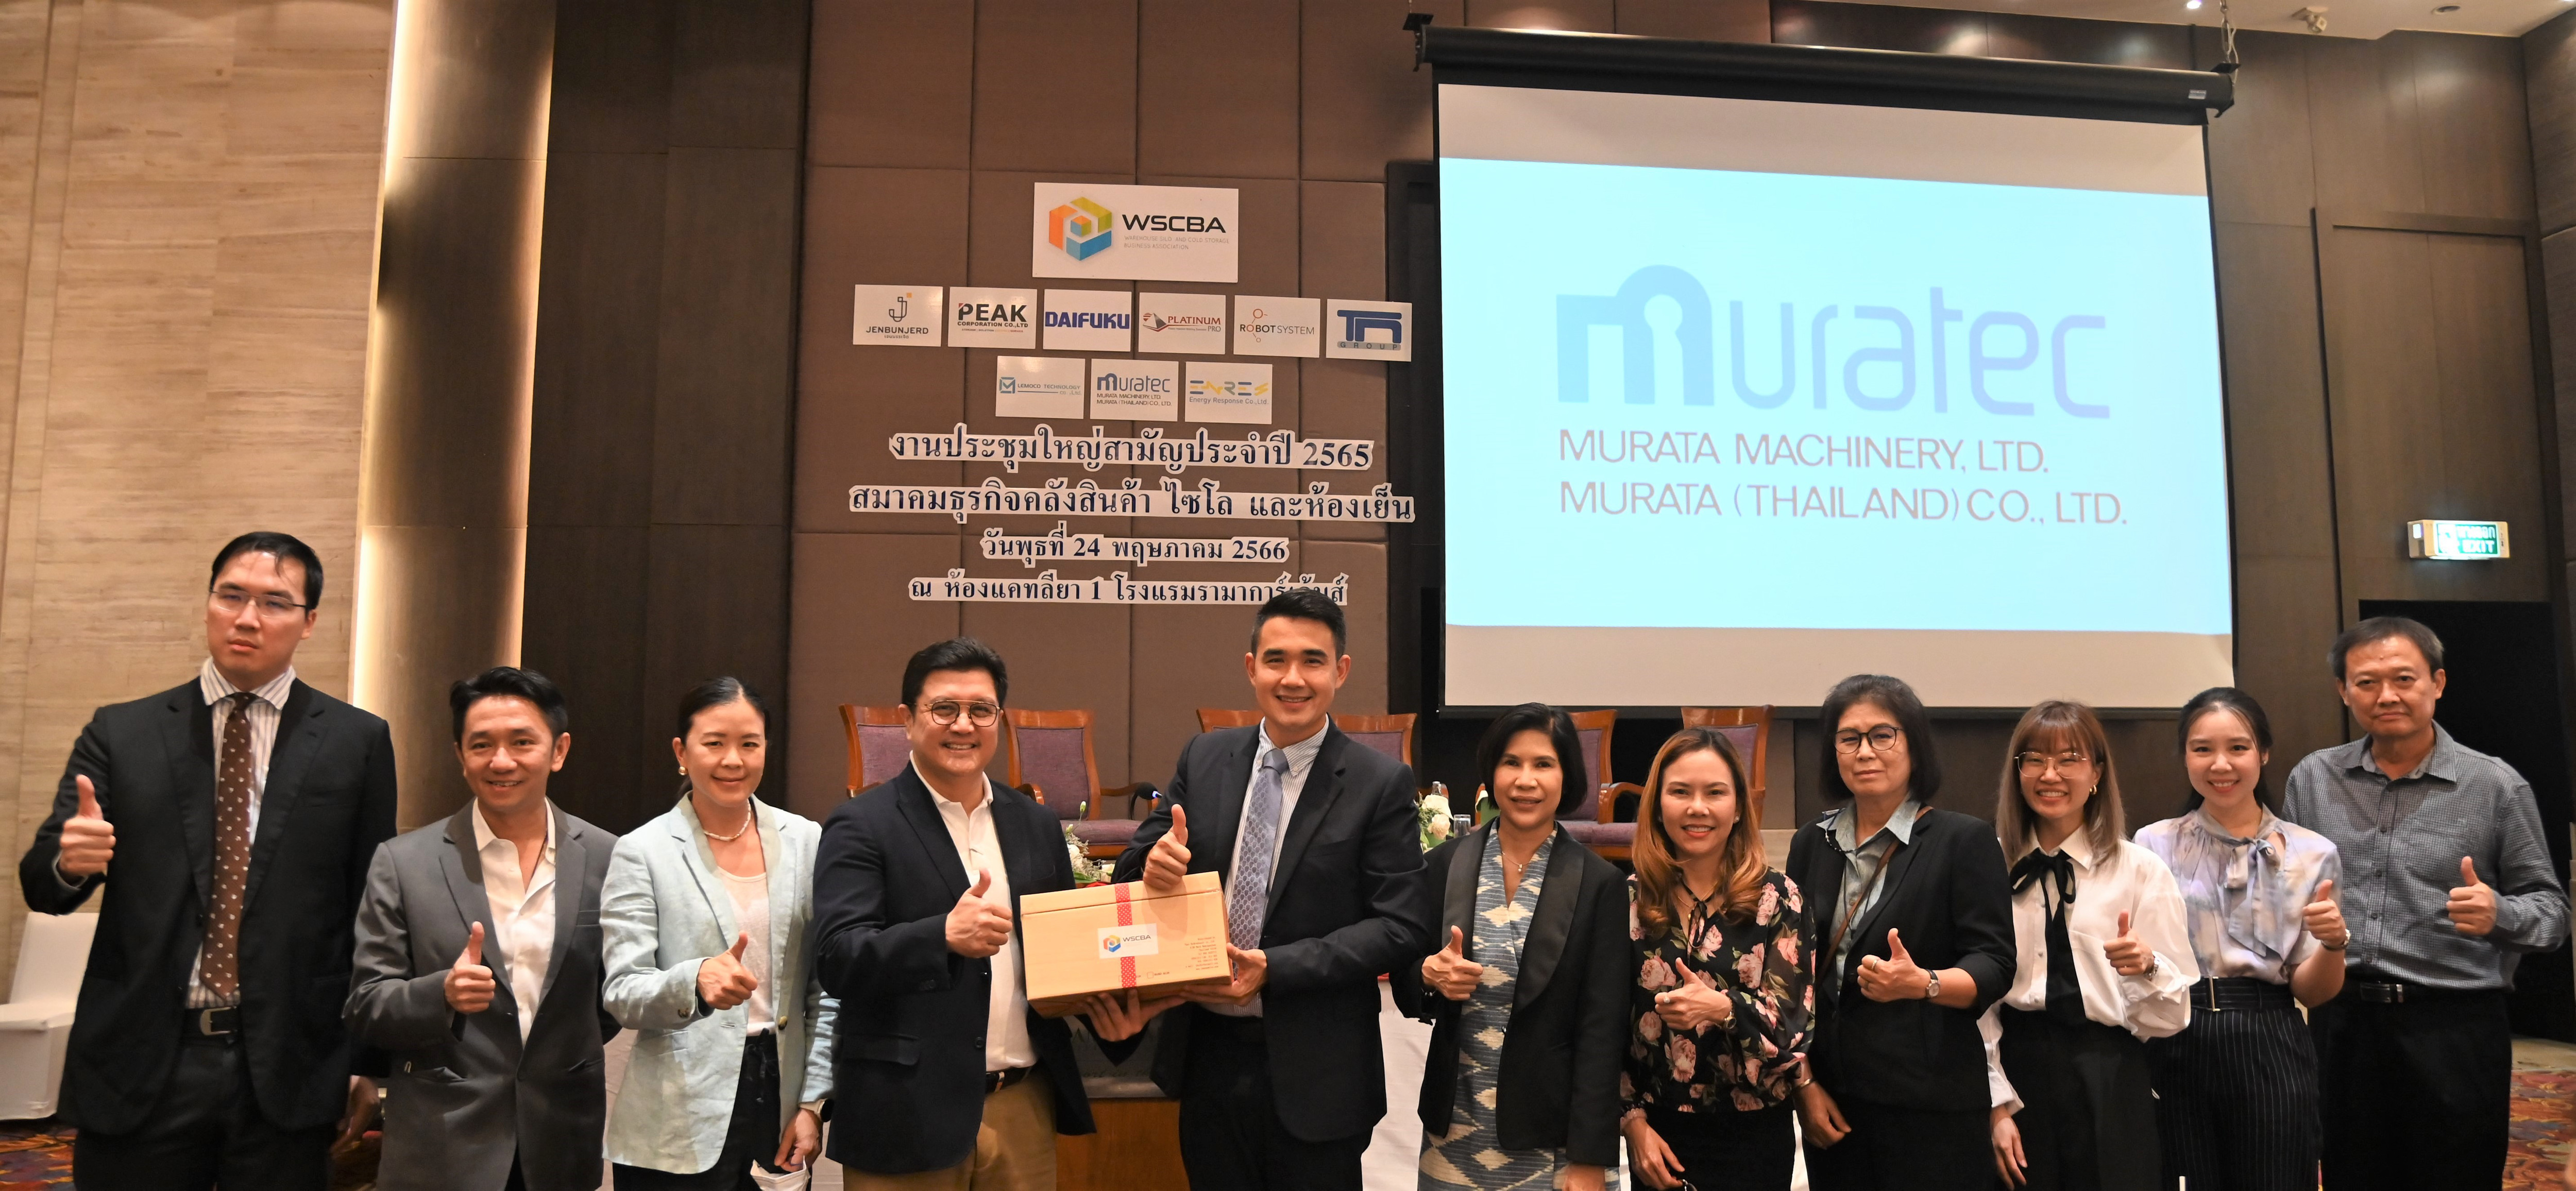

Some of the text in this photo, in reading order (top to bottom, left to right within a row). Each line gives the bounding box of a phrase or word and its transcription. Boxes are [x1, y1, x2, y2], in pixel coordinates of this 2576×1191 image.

[1122, 214, 1227, 233] WSCBA
[958, 303, 1027, 322] PEAK
[1045, 312, 1130, 329] DAIFUKU
[1168, 316, 1221, 325] PLATINUM
[866, 326, 929, 334] JENBUNJERD
[1340, 342, 1398, 350] GROUP
[891, 425, 1371, 471] งานประชุมใหญ่สามัญประจำปี 2565
[1560, 429, 2048, 473] MURATA MACHINERY, LTD.
[853, 479, 1411, 522] สมาคมธุรกิจคลังสินค้า ไซโล และห้องเย็น
[1561, 481, 2127, 524] MURATA (THAILAND) CO., LTD.
[985, 522, 1286, 566] วันพุธที่ 24 พฤษภาคม 2566
[2462, 540, 2495, 553] EXIT
[912, 581, 931, 597] ณ
[944, 571, 1080, 599] ห้องแคทลียา
[1091, 581, 1101, 600] 1
